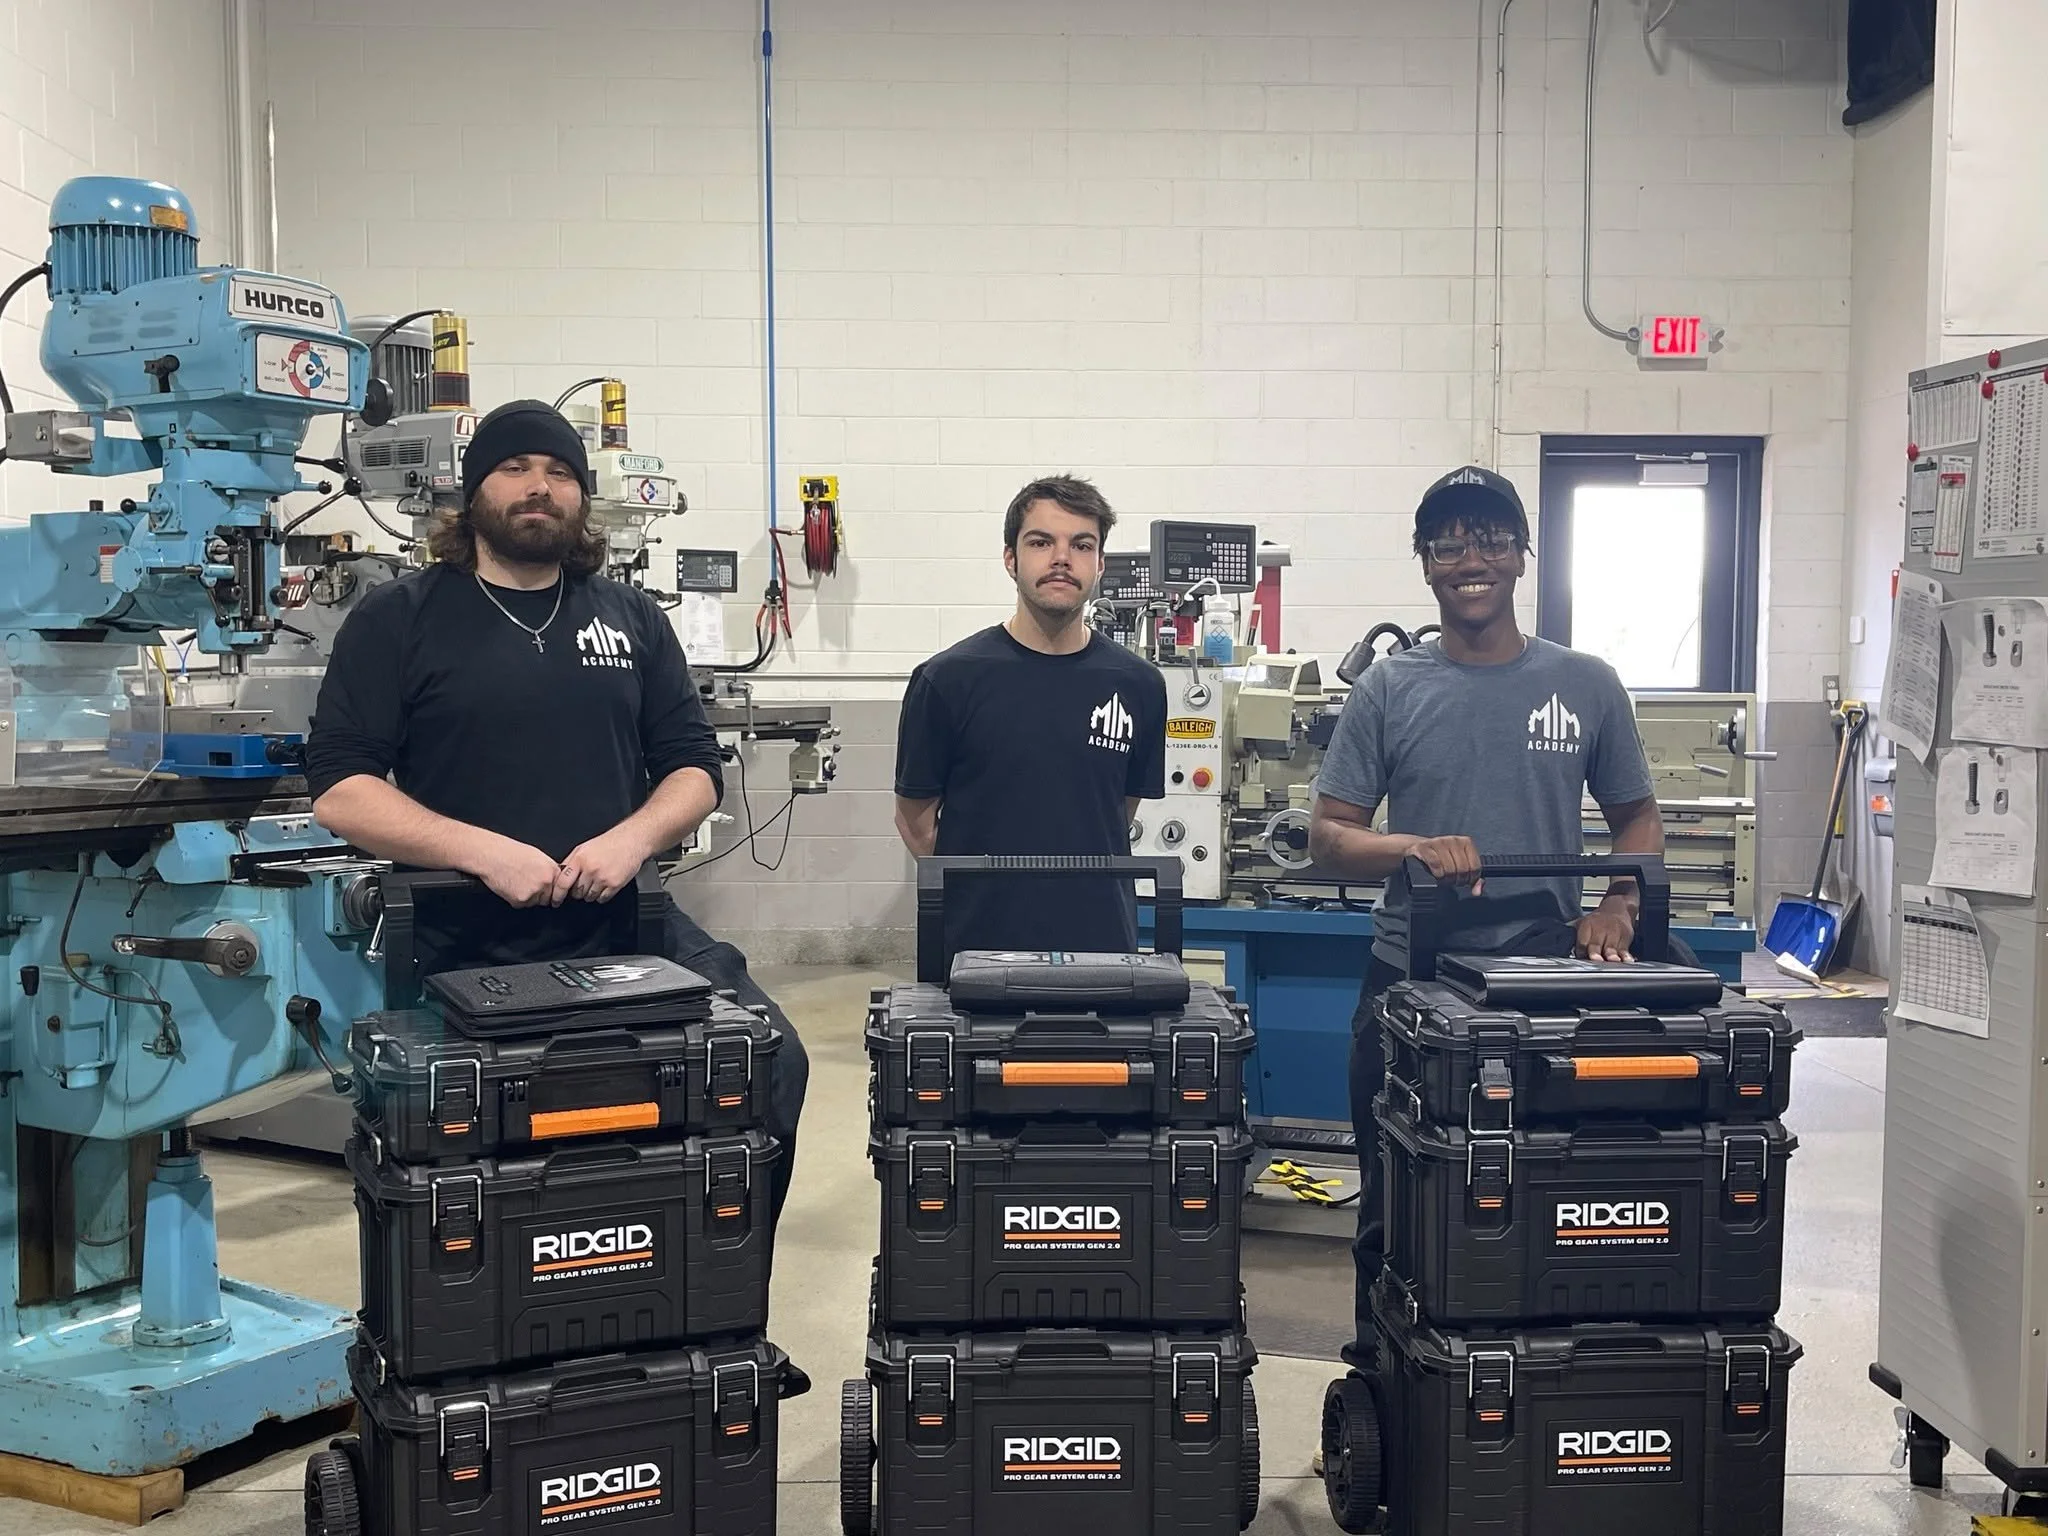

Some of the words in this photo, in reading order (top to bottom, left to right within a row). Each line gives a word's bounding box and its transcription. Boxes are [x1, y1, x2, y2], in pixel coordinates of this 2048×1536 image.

[245, 289, 324, 318] HURCO
[1654, 317, 1700, 353] EXIT
[582, 656, 633, 670] ACADEMY
[1168, 721, 1213, 733] BAILEIGH
[1088, 734, 1130, 754] ACADEMY
[1527, 740, 1580, 755] ACADEMY
[1004, 1206, 1121, 1230] RIDGID
[1557, 1202, 1669, 1227] RIDGID
[533, 1224, 653, 1262] RIDGID
[533, 1274, 552, 1283] PRO
[553, 1270, 579, 1280] GEAR
[581, 1265, 617, 1276] SYSTEM
[619, 1263, 638, 1271] GEN
[639, 1261, 653, 1269] 2.0
[1004, 1437, 1121, 1461] RIDGID
[1559, 1430, 1672, 1456] RIDGID
[1577, 1467, 1600, 1475] GEAR
[1602, 1466, 1637, 1474] SYSTEM
[541, 1462, 661, 1505] RIDGID
[541, 1516, 560, 1526] PRO
[562, 1511, 587, 1522] GEAR
[588, 1505, 625, 1517] SYSTEM
[627, 1501, 646, 1510] GEN
[647, 1499, 661, 1507] 2.0
